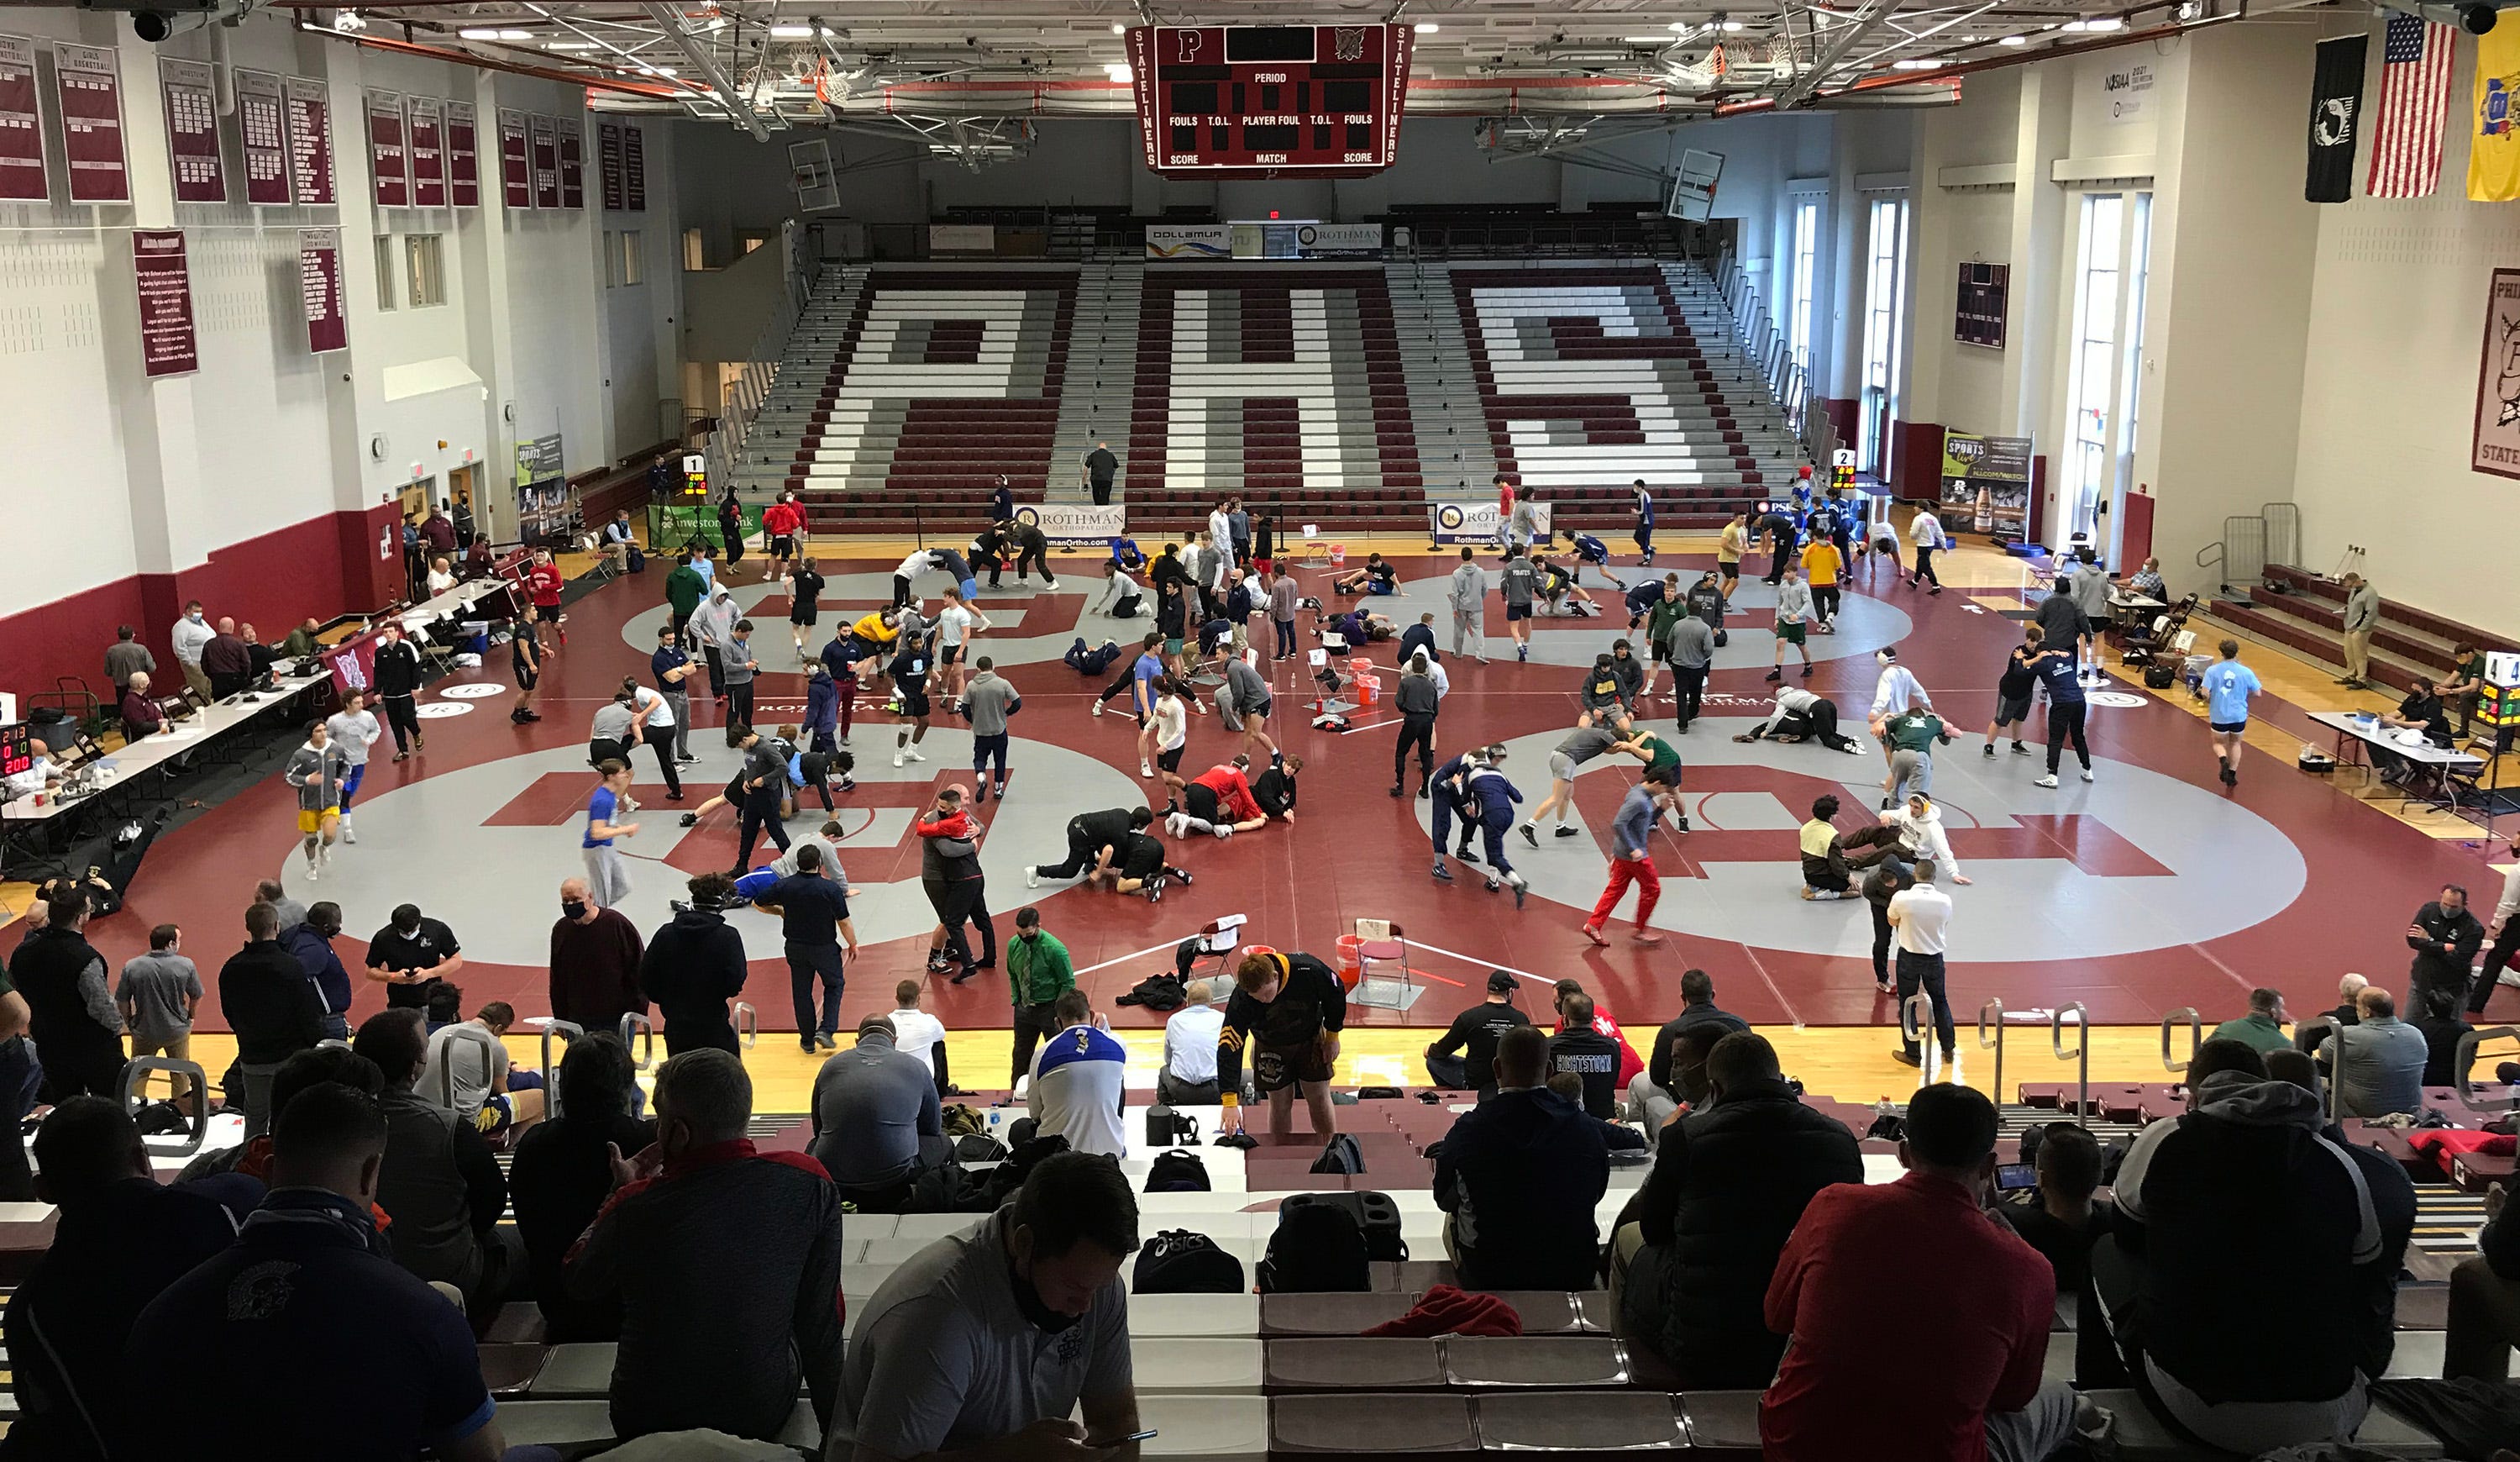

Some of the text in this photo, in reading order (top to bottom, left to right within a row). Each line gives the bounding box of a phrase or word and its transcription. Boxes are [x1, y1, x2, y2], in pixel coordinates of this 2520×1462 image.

[1179, 30, 1201, 62] P
[2133, 66, 2147, 76] 2021
[1255, 73, 1287, 83] PERIOD
[1135, 30, 1156, 166] STATELINERS
[1386, 27, 1405, 163] STATELINERS
[1169, 117, 1198, 127] FOULS
[1207, 117, 1231, 126] T.O.L.
[1242, 116, 1300, 126] PLAYER FOUL
[1310, 115, 1334, 125] T.O.L.
[1344, 115, 1373, 124] FOULS
[1170, 155, 1199, 165] SCORE
[1256, 154, 1287, 164] MATCH
[1344, 153, 1373, 163] SCORE
[1319, 230, 1380, 239] ROTHMAN
[1948, 443, 1984, 455] SPORTS
[1840, 453, 1847, 465] 2
[2482, 444, 2520, 465] STATE
[690, 459, 696, 471] 1
[1024, 514, 1032, 523] R
[1042, 514, 1124, 524] ROTHMAN
[1446, 513, 1456, 522] R
[2490, 659, 2497, 680] 4
[2511, 661, 2520, 681] 4
[5, 756, 29, 774] 200
[1557, 1054, 1612, 1072] HIGHTSTOWN
